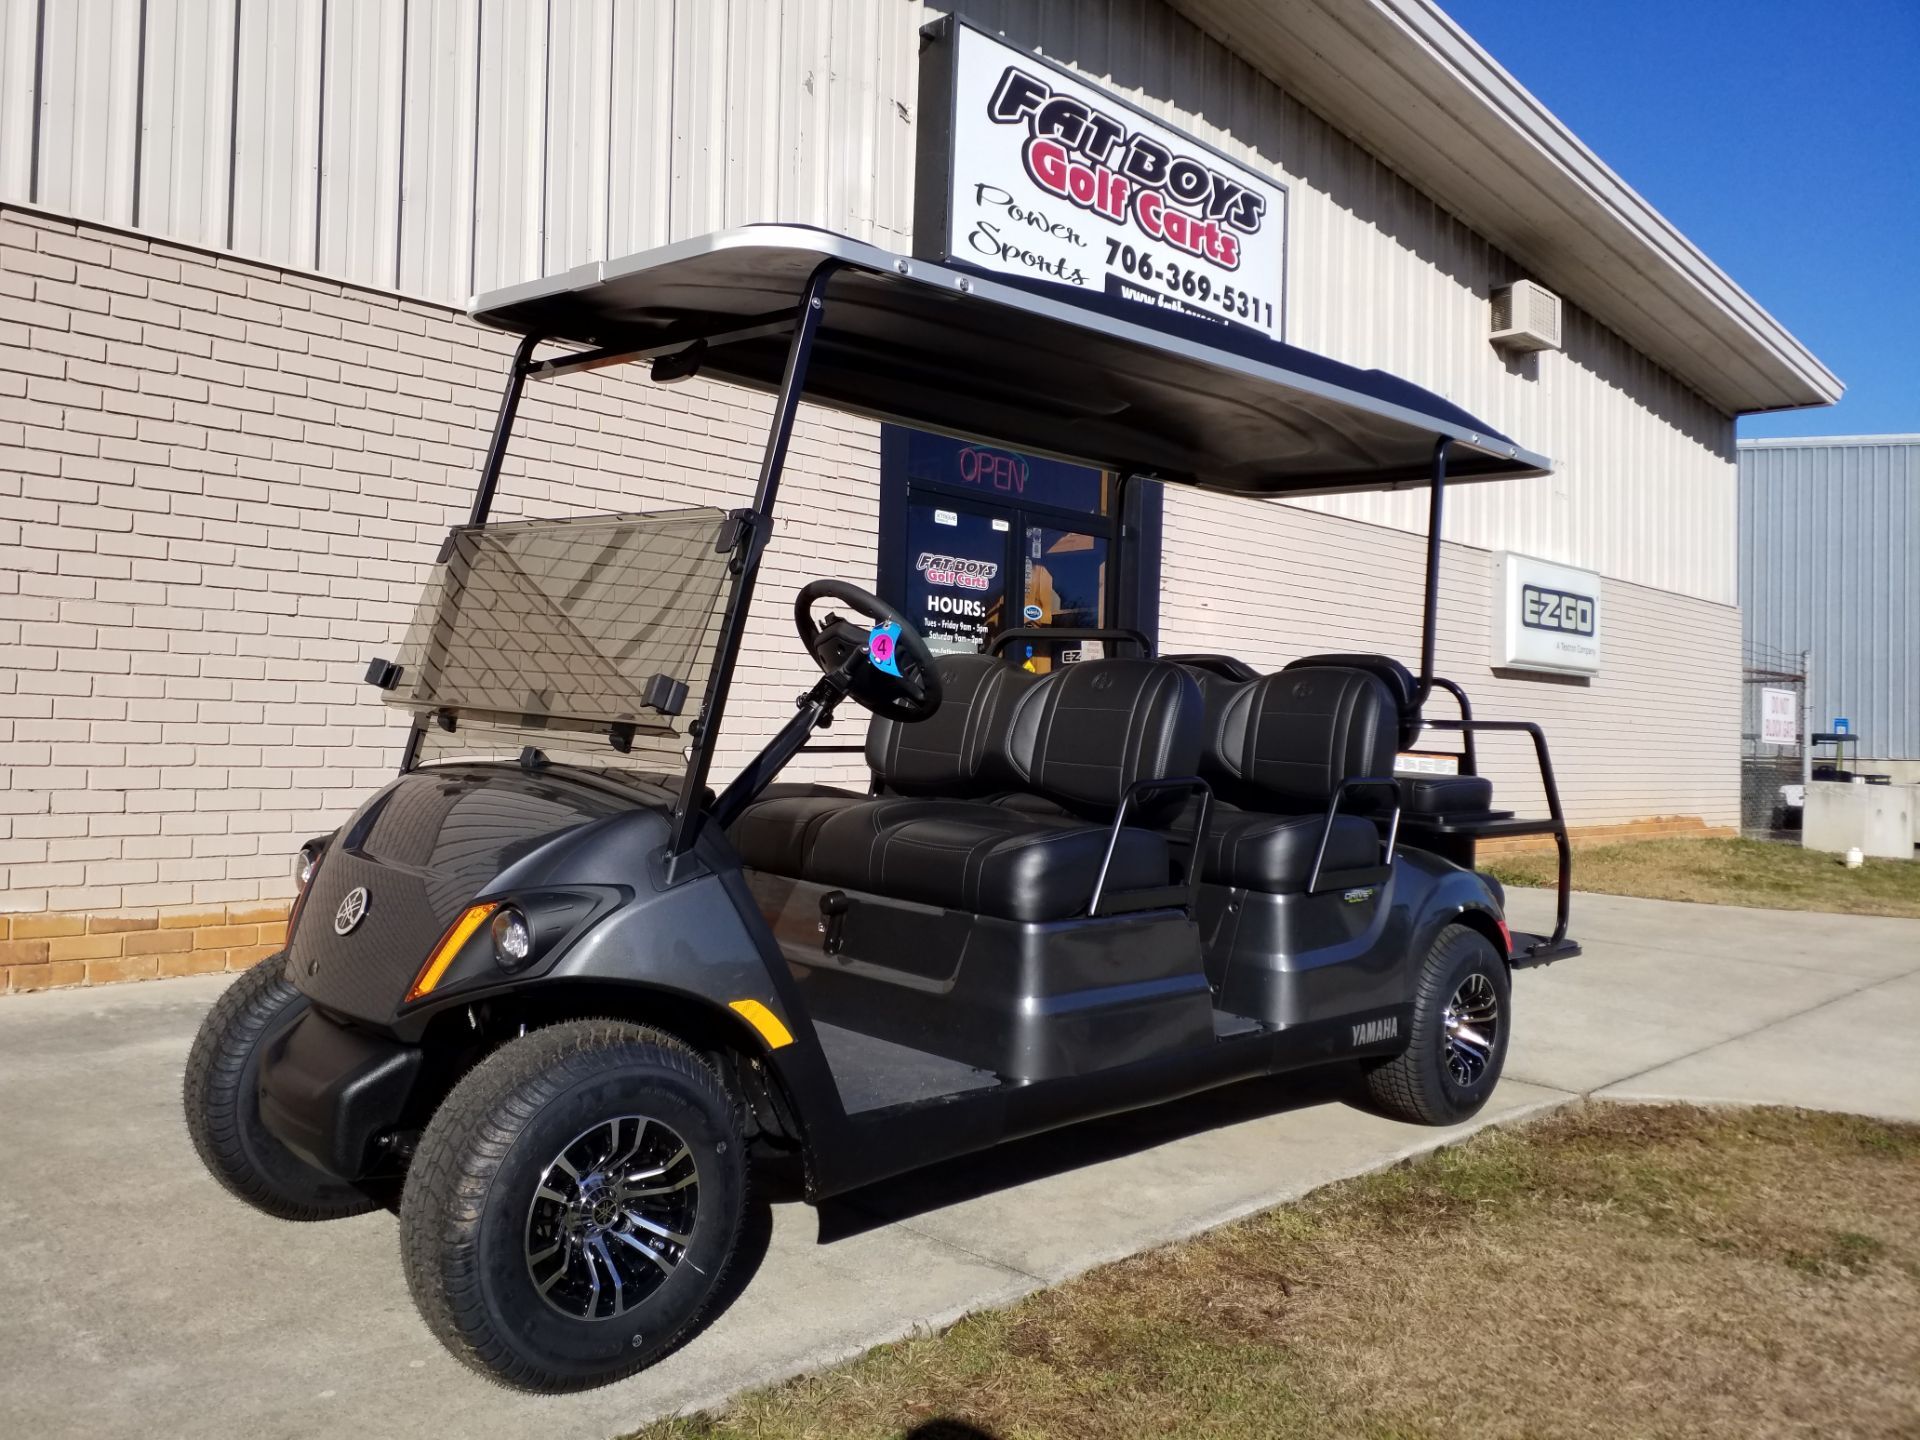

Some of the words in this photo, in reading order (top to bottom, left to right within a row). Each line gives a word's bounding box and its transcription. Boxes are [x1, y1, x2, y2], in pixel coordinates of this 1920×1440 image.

[988, 66, 1127, 159] FAT
[1124, 132, 1266, 235] BOYS
[974, 183, 1088, 248] Power
[1022, 138, 1130, 226] Golf
[1133, 190, 1241, 272] Carts
[968, 220, 1090, 286] Sports
[1105, 237, 1274, 328] 706-369-5311
[959, 447, 1025, 493] OPEN
[916, 552, 954, 571] FAT
[954, 558, 997, 579] BOYS
[926, 568, 955, 585] Golf
[956, 573, 988, 590] Carts
[924, 617, 937, 628] Tues
[941, 619, 959, 632] Friday
[960, 621, 972, 632] 9am
[928, 595, 986, 618] HOURS:
[1523, 587, 1593, 635] EZGO
[877, 639, 887, 656] 4
[929, 631, 953, 643] Saturday
[1352, 1016, 1398, 1047] YAMAHA
